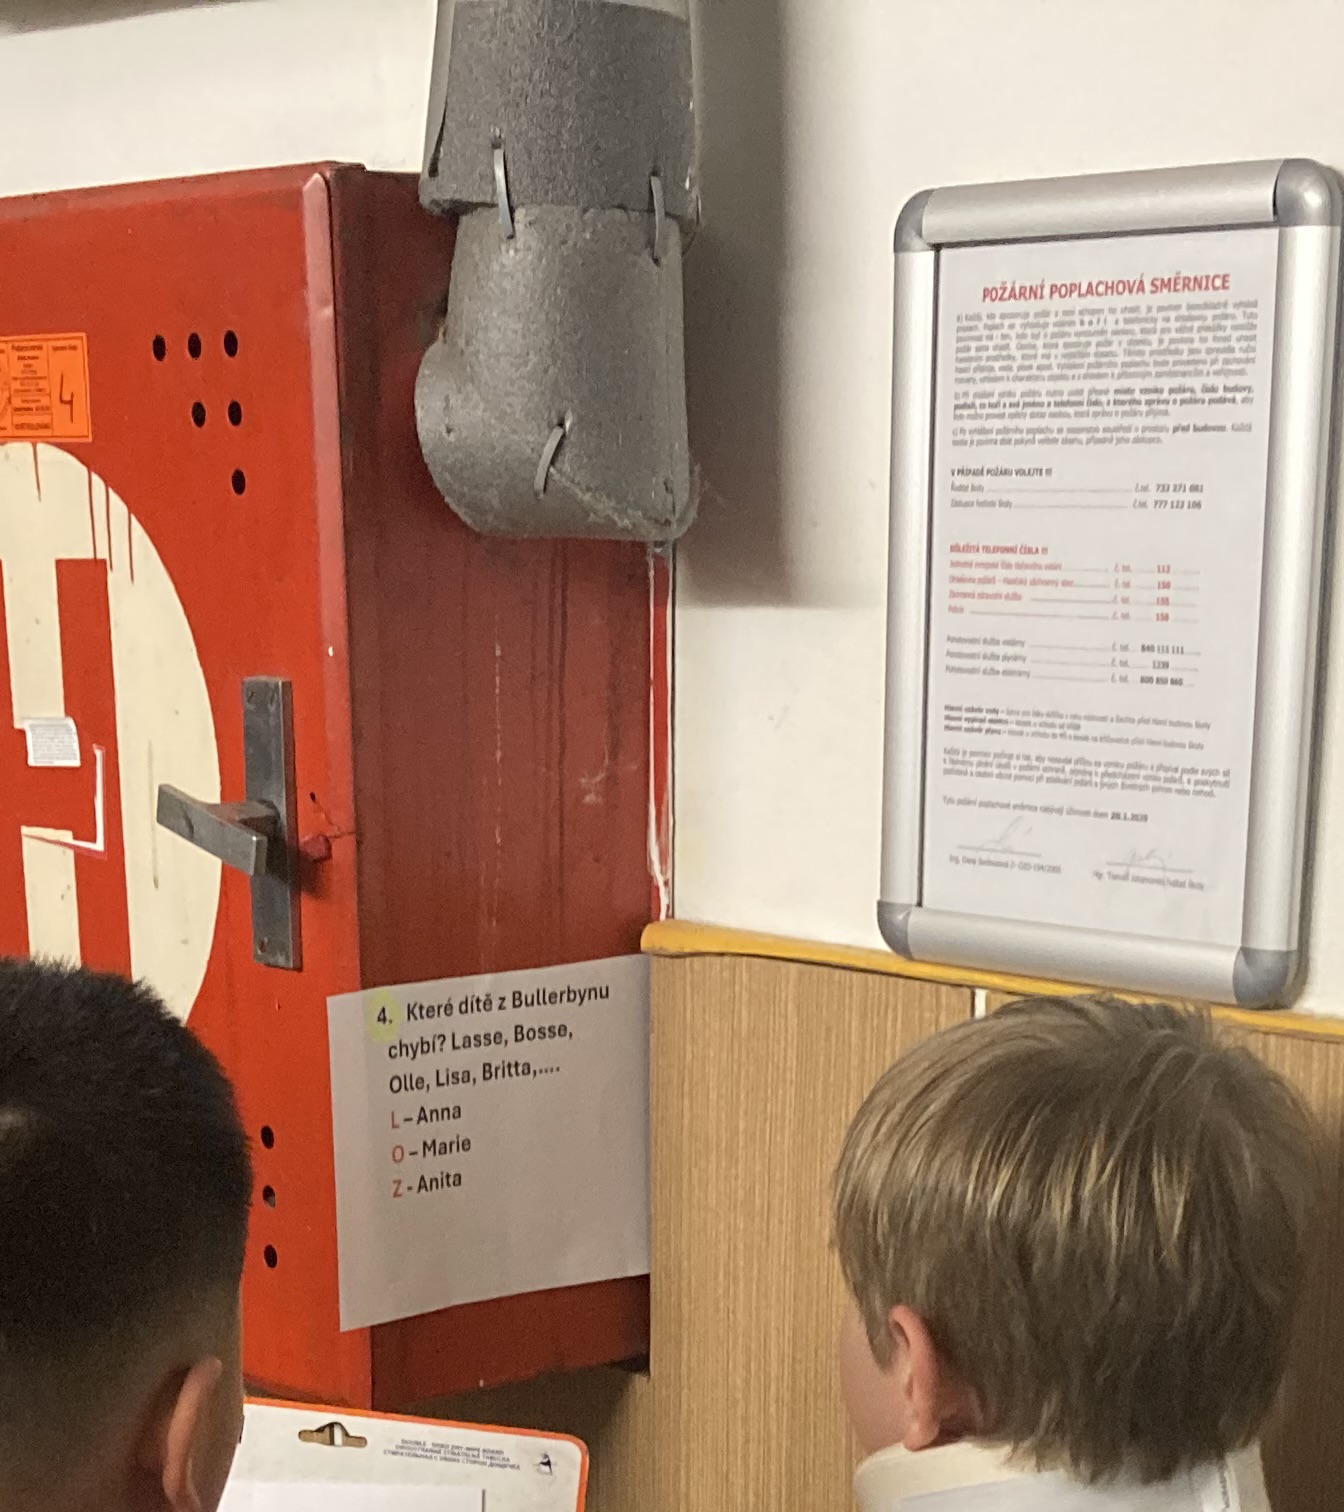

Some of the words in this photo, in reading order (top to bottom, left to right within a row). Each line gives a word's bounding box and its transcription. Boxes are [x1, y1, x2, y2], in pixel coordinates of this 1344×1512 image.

[982, 278, 1045, 303] POŽÁRNÍ
[1049, 273, 1146, 300] POPLACHOVÁ
[1149, 271, 1231, 295] SMĚRNICE
[377, 1006, 393, 1025] 4.
[407, 1000, 454, 1022] Které
[459, 994, 493, 1015] dítě
[498, 997, 507, 1011] z
[512, 985, 609, 1009] Bullerbynu
[388, 1033, 446, 1061] chybí?
[452, 1030, 508, 1050] Lasse,
[514, 1023, 573, 1043] Bosse,
[389, 1075, 430, 1094] Olle,
[436, 1067, 476, 1088] Lisa,
[391, 1111, 400, 1129] L
[416, 1105, 462, 1125] Anna
[392, 1145, 404, 1164] O
[422, 1134, 472, 1158] Marie
[392, 1179, 403, 1198] Z
[416, 1171, 462, 1194] Anita
